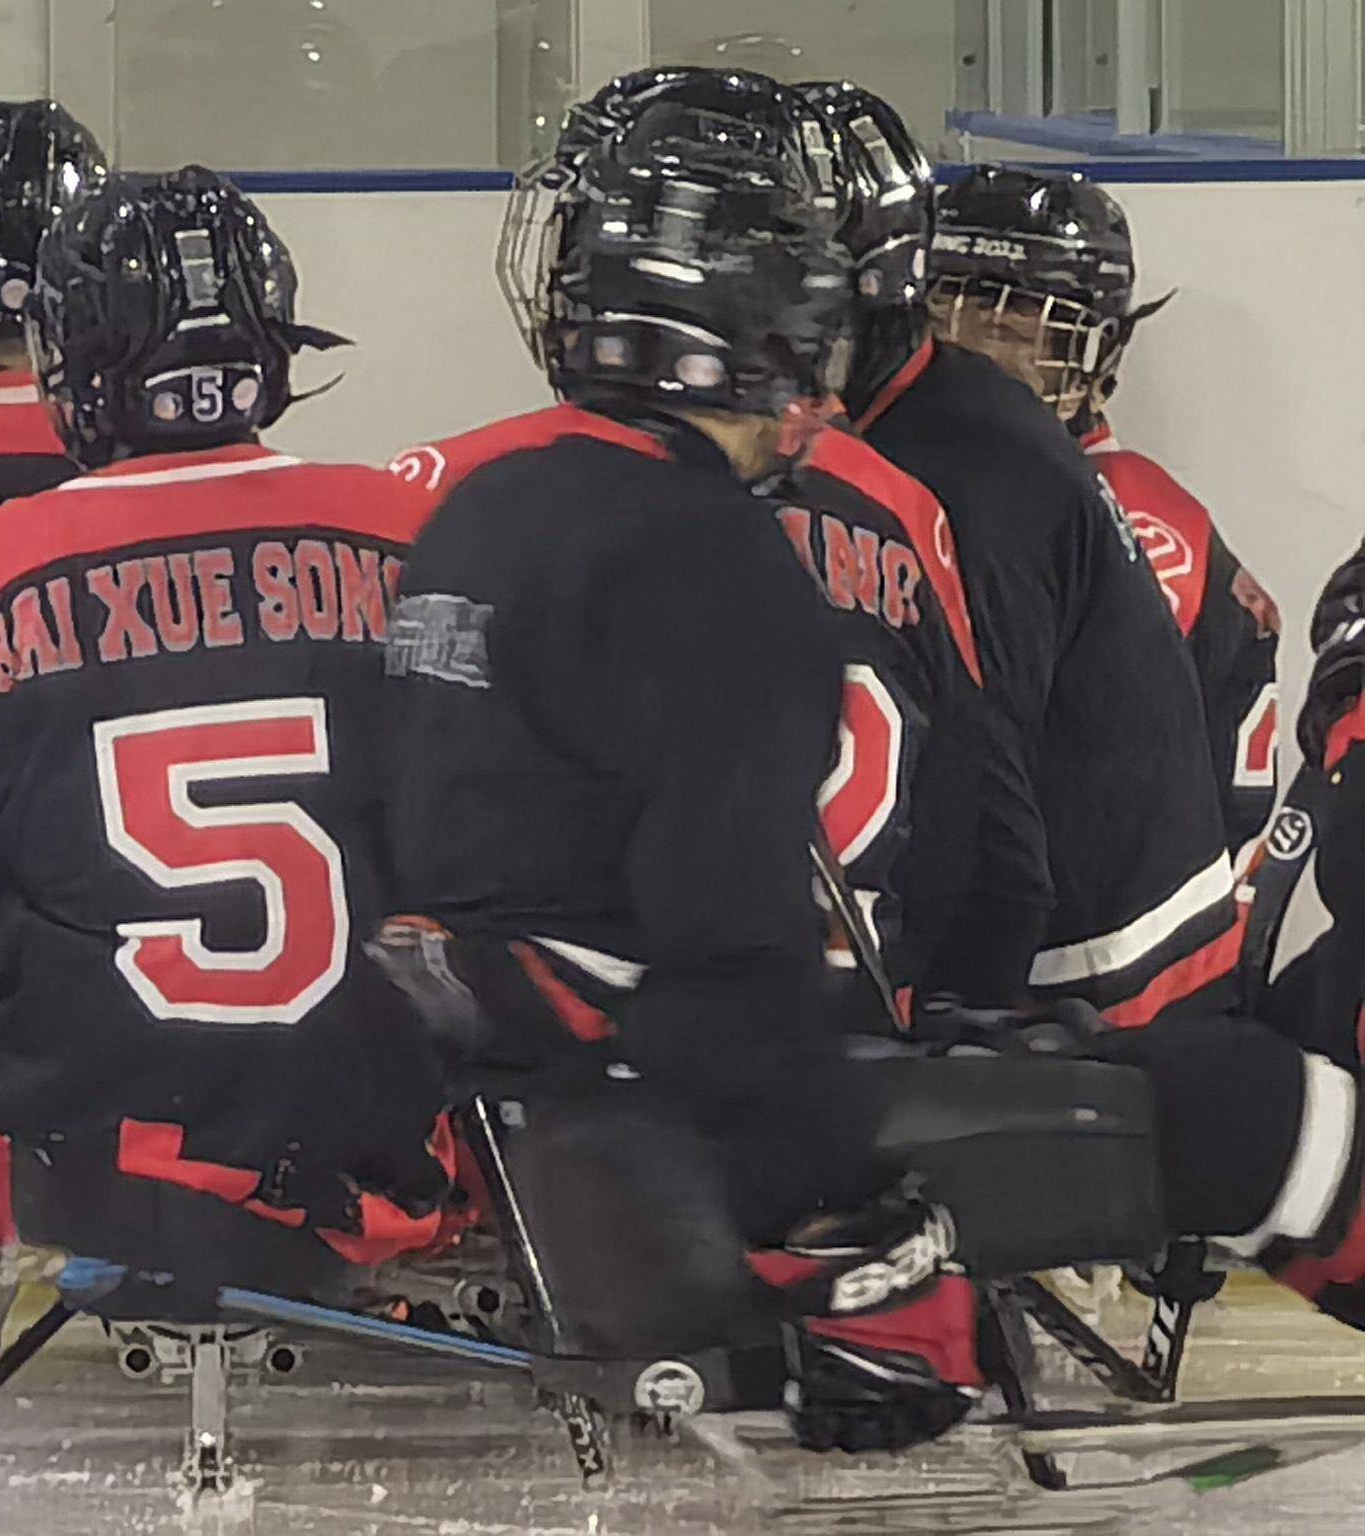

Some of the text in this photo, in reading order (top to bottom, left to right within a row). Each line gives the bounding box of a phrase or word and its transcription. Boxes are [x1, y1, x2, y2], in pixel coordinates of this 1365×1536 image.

[191, 368, 224, 423] 5
[85, 548, 244, 663] XUE
[92, 695, 351, 1025] 5
